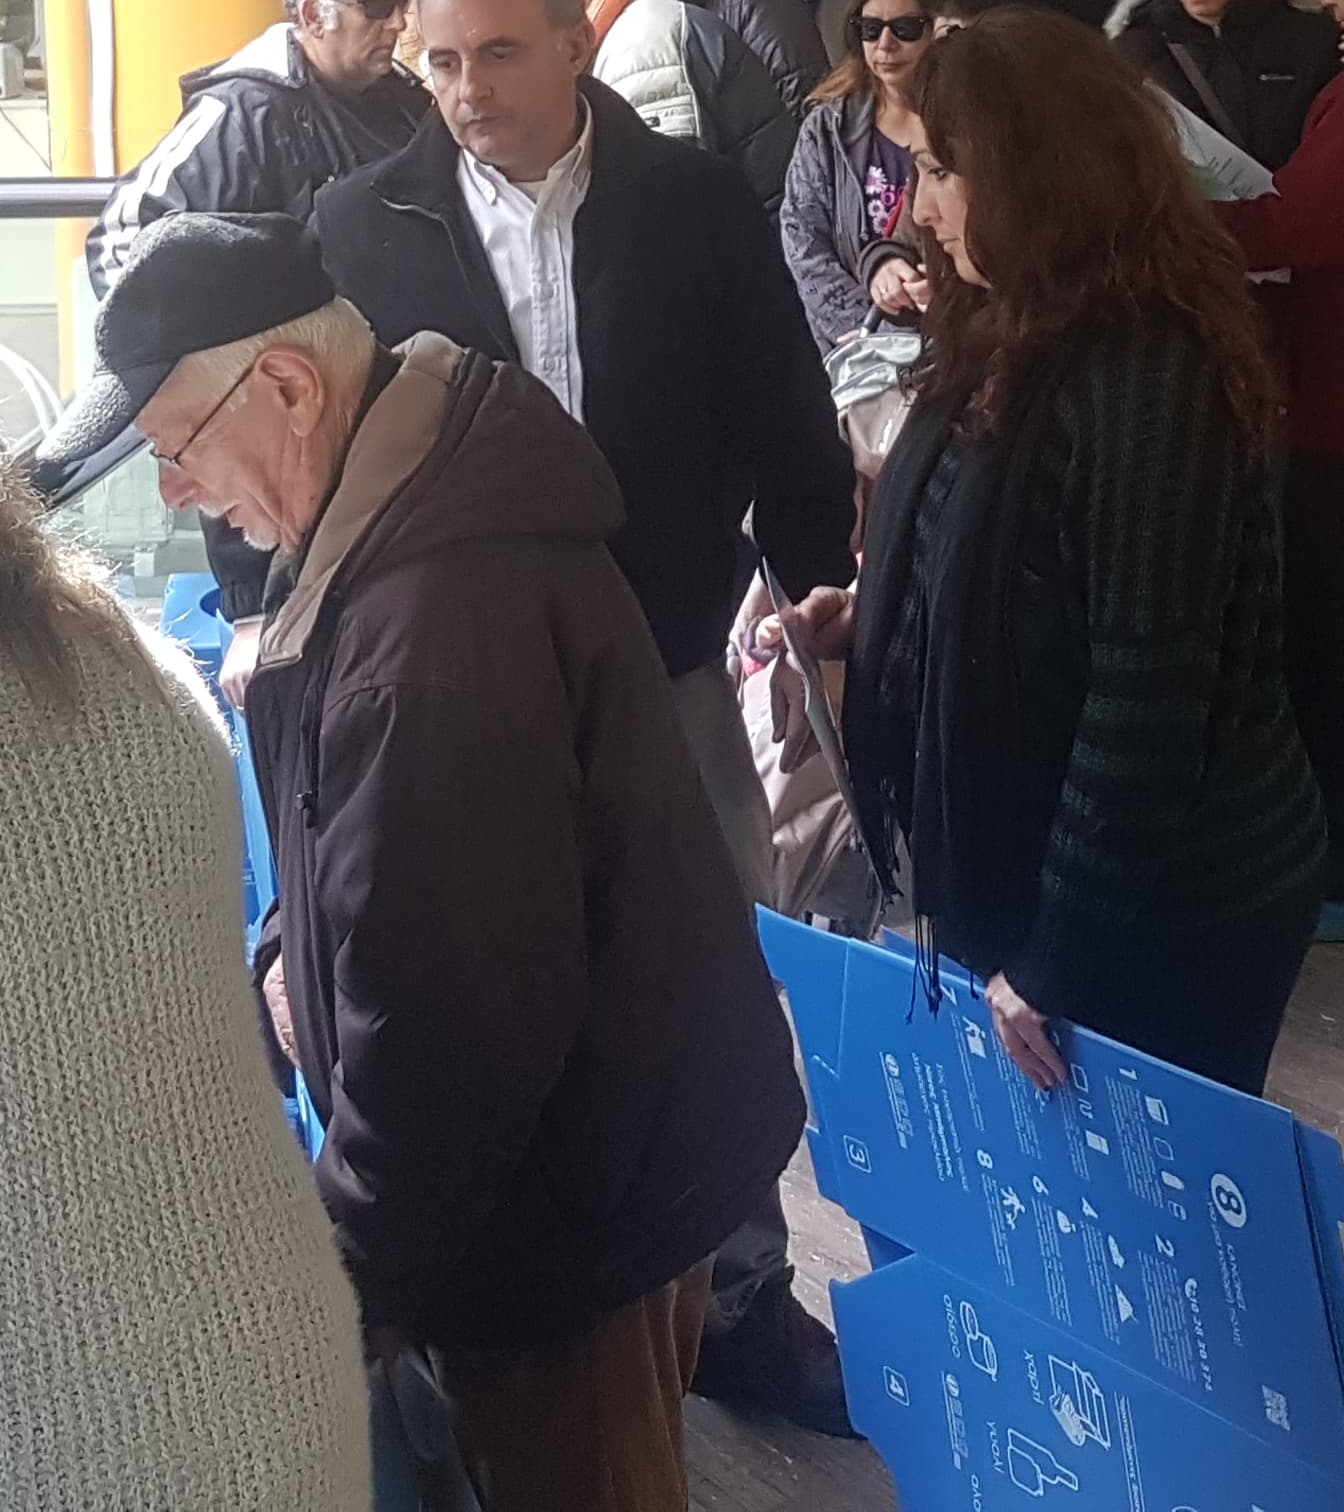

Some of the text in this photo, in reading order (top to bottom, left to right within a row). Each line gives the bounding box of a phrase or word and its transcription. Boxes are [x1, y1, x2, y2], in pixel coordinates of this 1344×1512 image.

[1118, 1066, 1139, 1081] 1
[976, 1148, 994, 1170] 8
[1032, 1175, 1049, 1196] 6
[1081, 1196, 1099, 1219] 4
[1214, 1184, 1243, 1217] 8
[1155, 1232, 1175, 1257] 2
